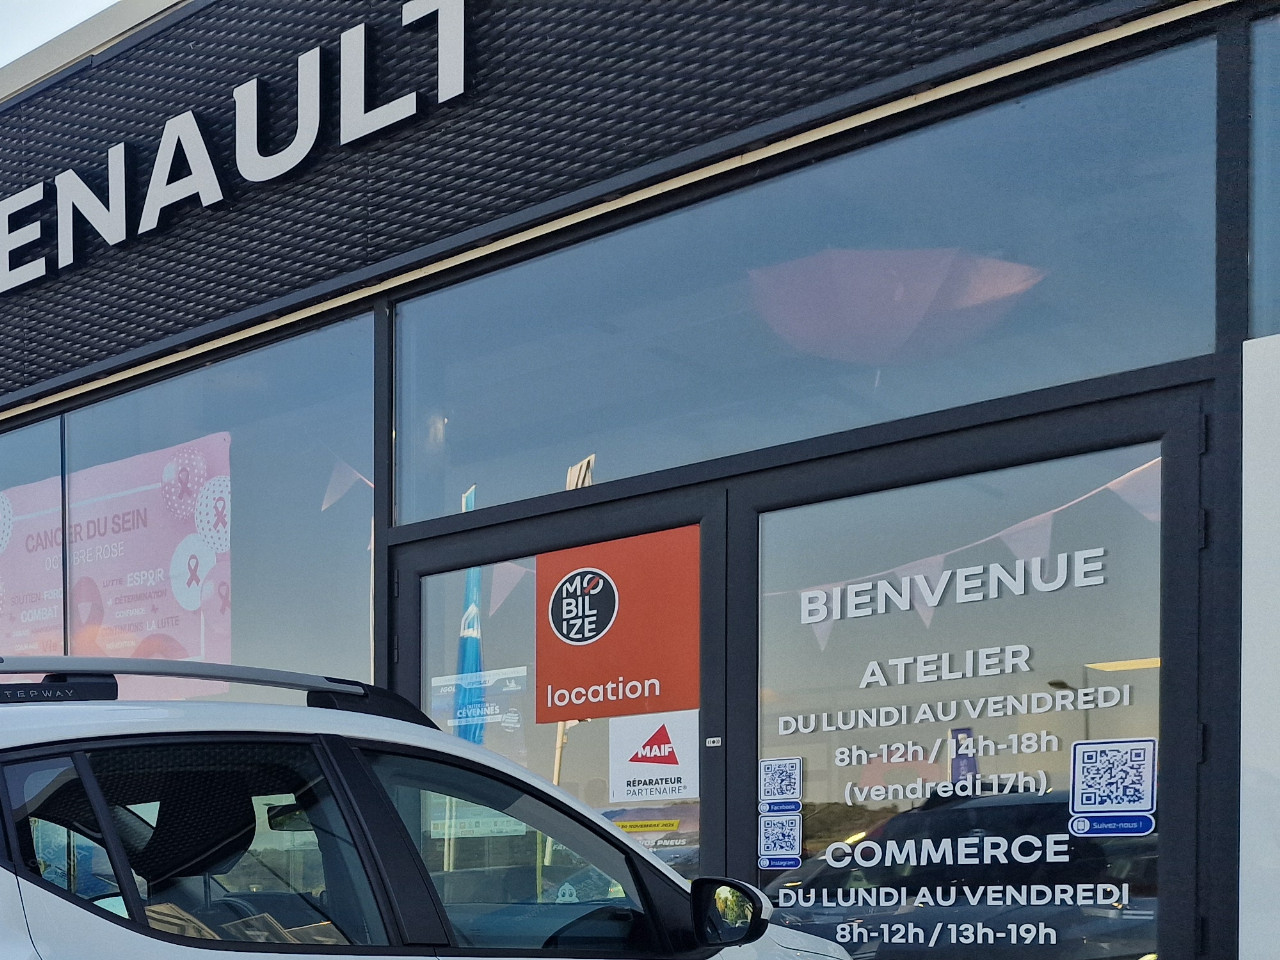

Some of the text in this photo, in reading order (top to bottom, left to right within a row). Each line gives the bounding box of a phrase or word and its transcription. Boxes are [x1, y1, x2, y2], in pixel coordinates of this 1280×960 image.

[86, 516, 108, 540] DU
[111, 507, 148, 535] SEIN
[95, 541, 125, 562] ROSE
[800, 547, 1104, 624] BIENVENUE
[859, 644, 1031, 688] ATELIER
[547, 676, 660, 707] location
[778, 684, 1130, 735] DU LUNDI AU VENDREDI
[637, 744, 674, 758] MAIF
[834, 740, 924, 766] 8h-12h
[947, 730, 1059, 759] 14h-18h
[626, 776, 683, 788] RÉPARATEUR
[844, 770, 1047, 806] (vendredi 17h)
[770, 803, 796, 812] Facebook
[656, 838, 687, 846] PNEUS
[825, 833, 1070, 868] COMMERCE
[770, 859, 796, 867] Instagram
[778, 883, 1129, 908] DU LUNDI AU VENDREDI
[835, 922, 925, 944] 8h-12h
[947, 922, 1057, 945] 13h-19h
